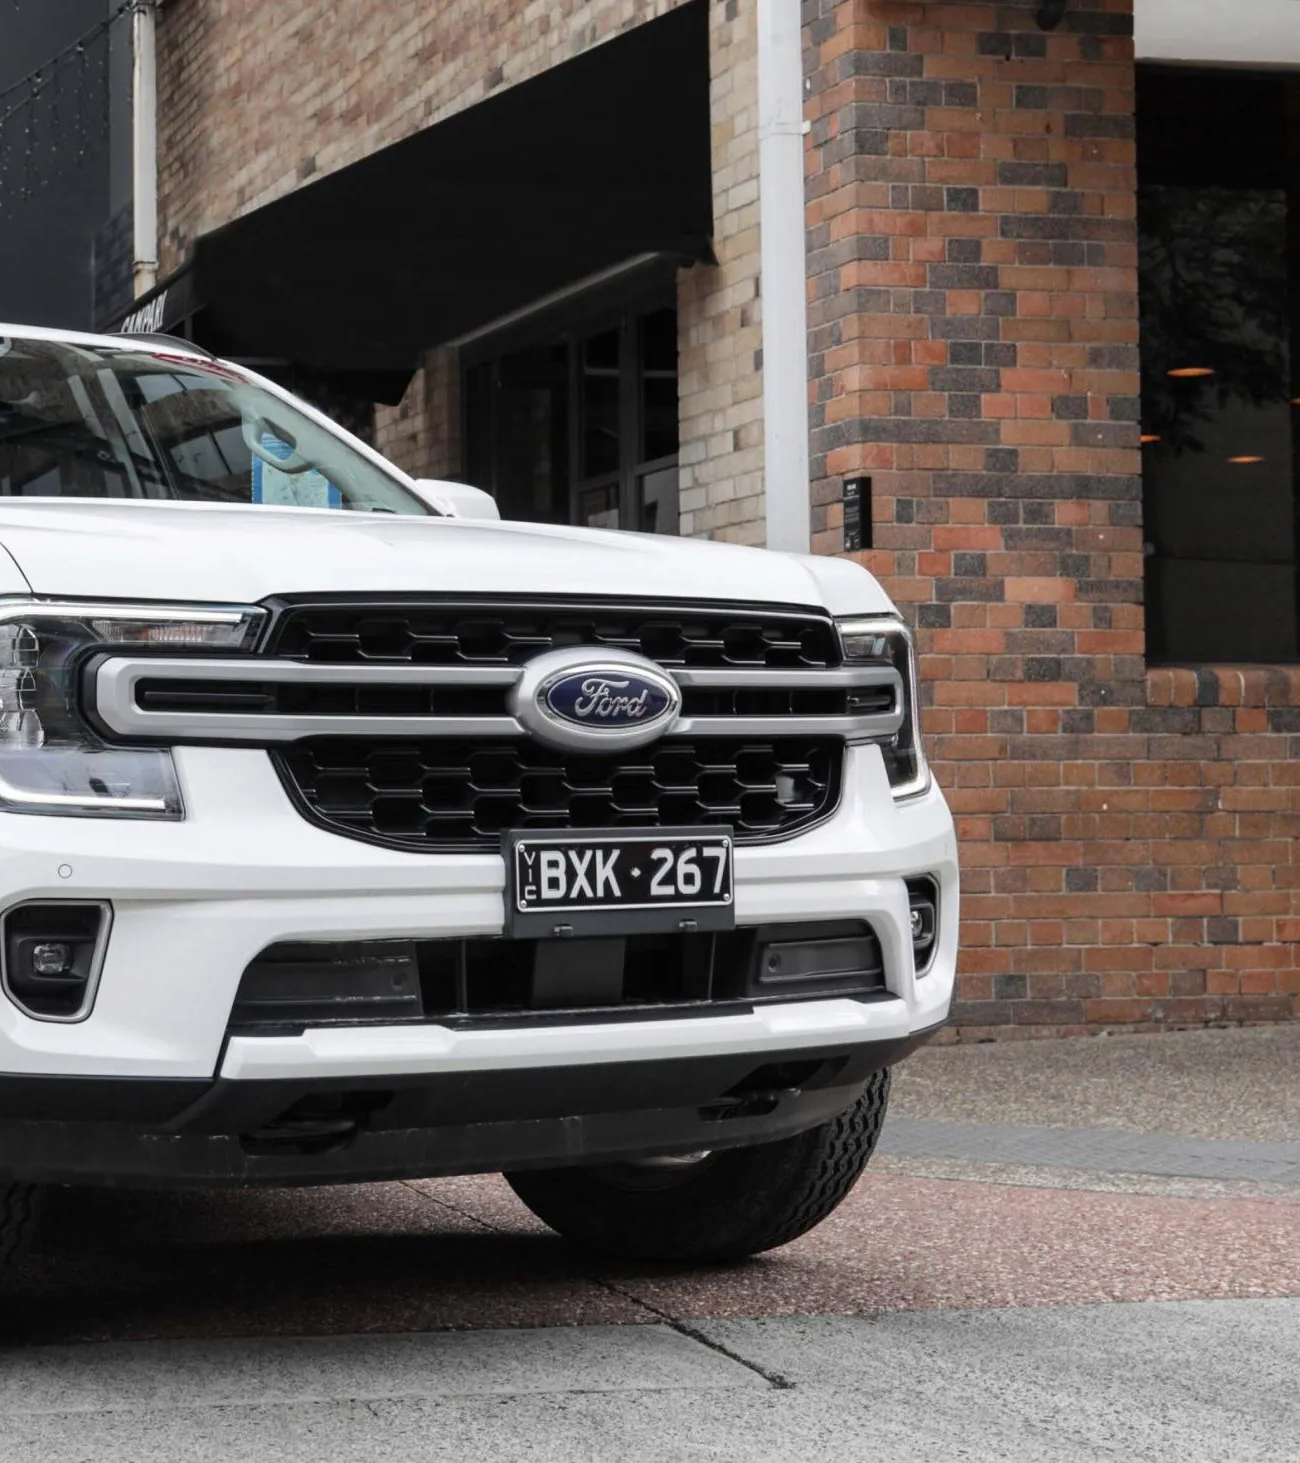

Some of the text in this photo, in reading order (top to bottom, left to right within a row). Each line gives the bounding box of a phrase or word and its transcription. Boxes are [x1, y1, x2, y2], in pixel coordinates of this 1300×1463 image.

[575, 678, 648, 717] Ford
[523, 851, 537, 900] VIC
[540, 846, 728, 899] BXK 267
